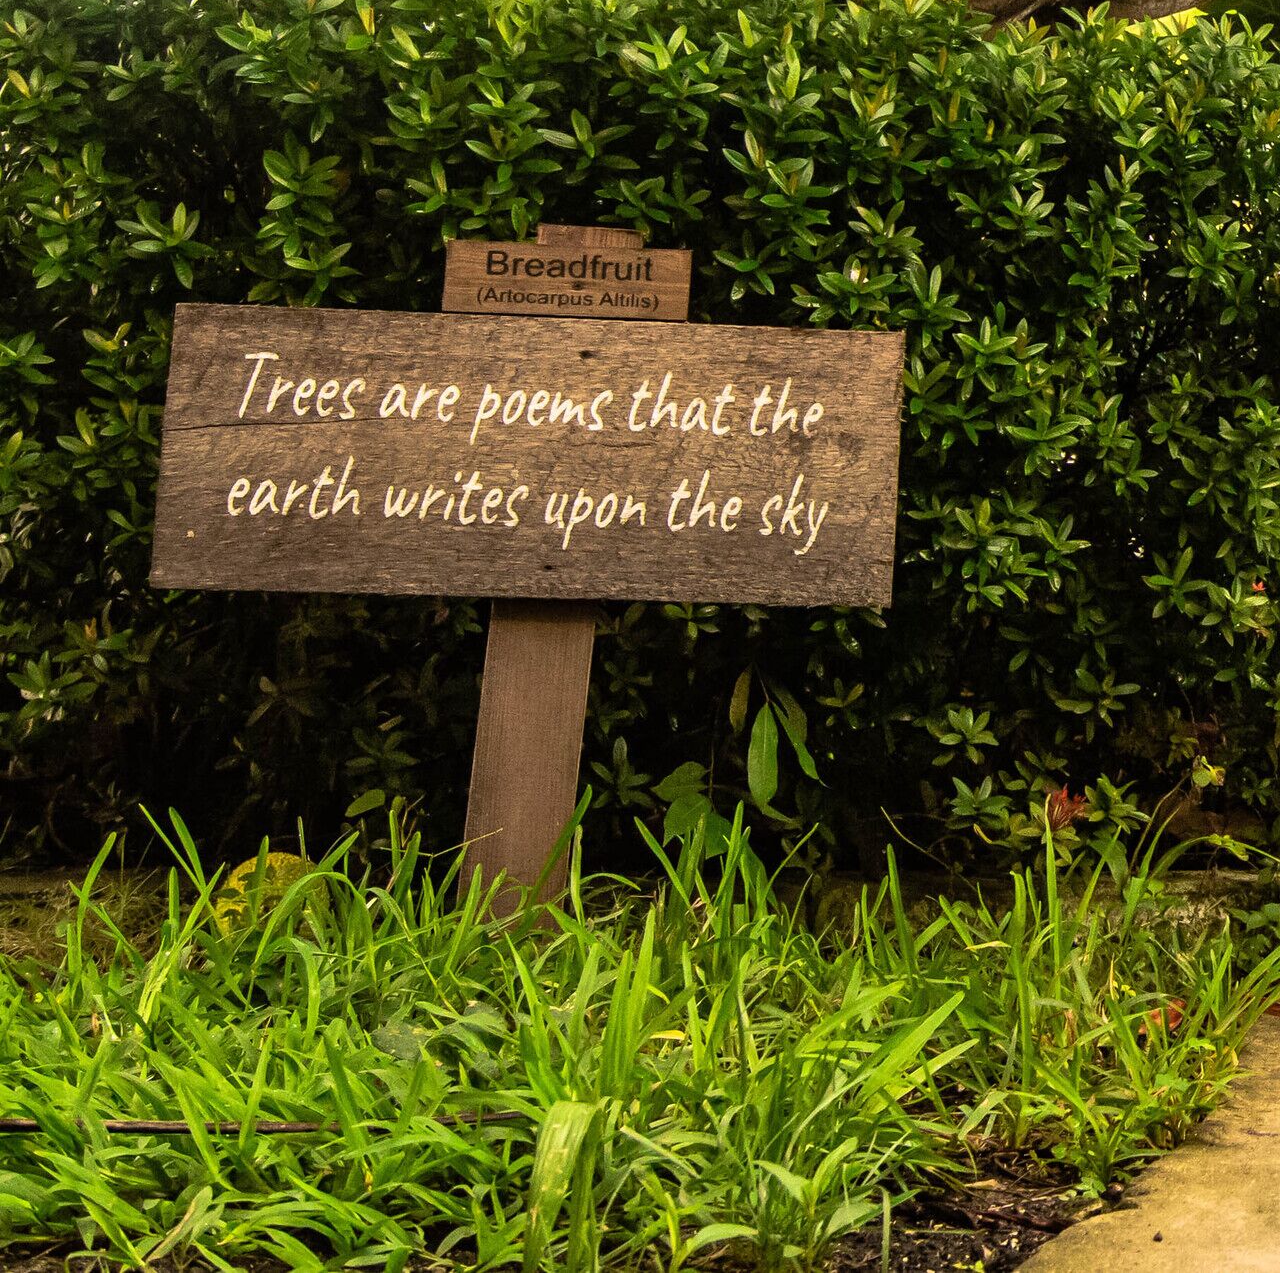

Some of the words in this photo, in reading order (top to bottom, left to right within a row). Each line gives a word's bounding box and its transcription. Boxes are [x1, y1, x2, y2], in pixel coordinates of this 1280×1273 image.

[486, 250, 653, 282] Breadfruit
[477, 287, 593, 308] (Artocarpus
[599, 292, 659, 311] Altilis)
[239, 351, 366, 420] Trees
[379, 380, 460, 422] are
[470, 385, 614, 444] poems
[629, 372, 735, 436] that
[750, 377, 824, 437] the
[227, 456, 361, 520] earth
[384, 470, 529, 529] writes
[544, 489, 647, 549] upon
[667, 470, 740, 532] the
[759, 473, 829, 556] sky
